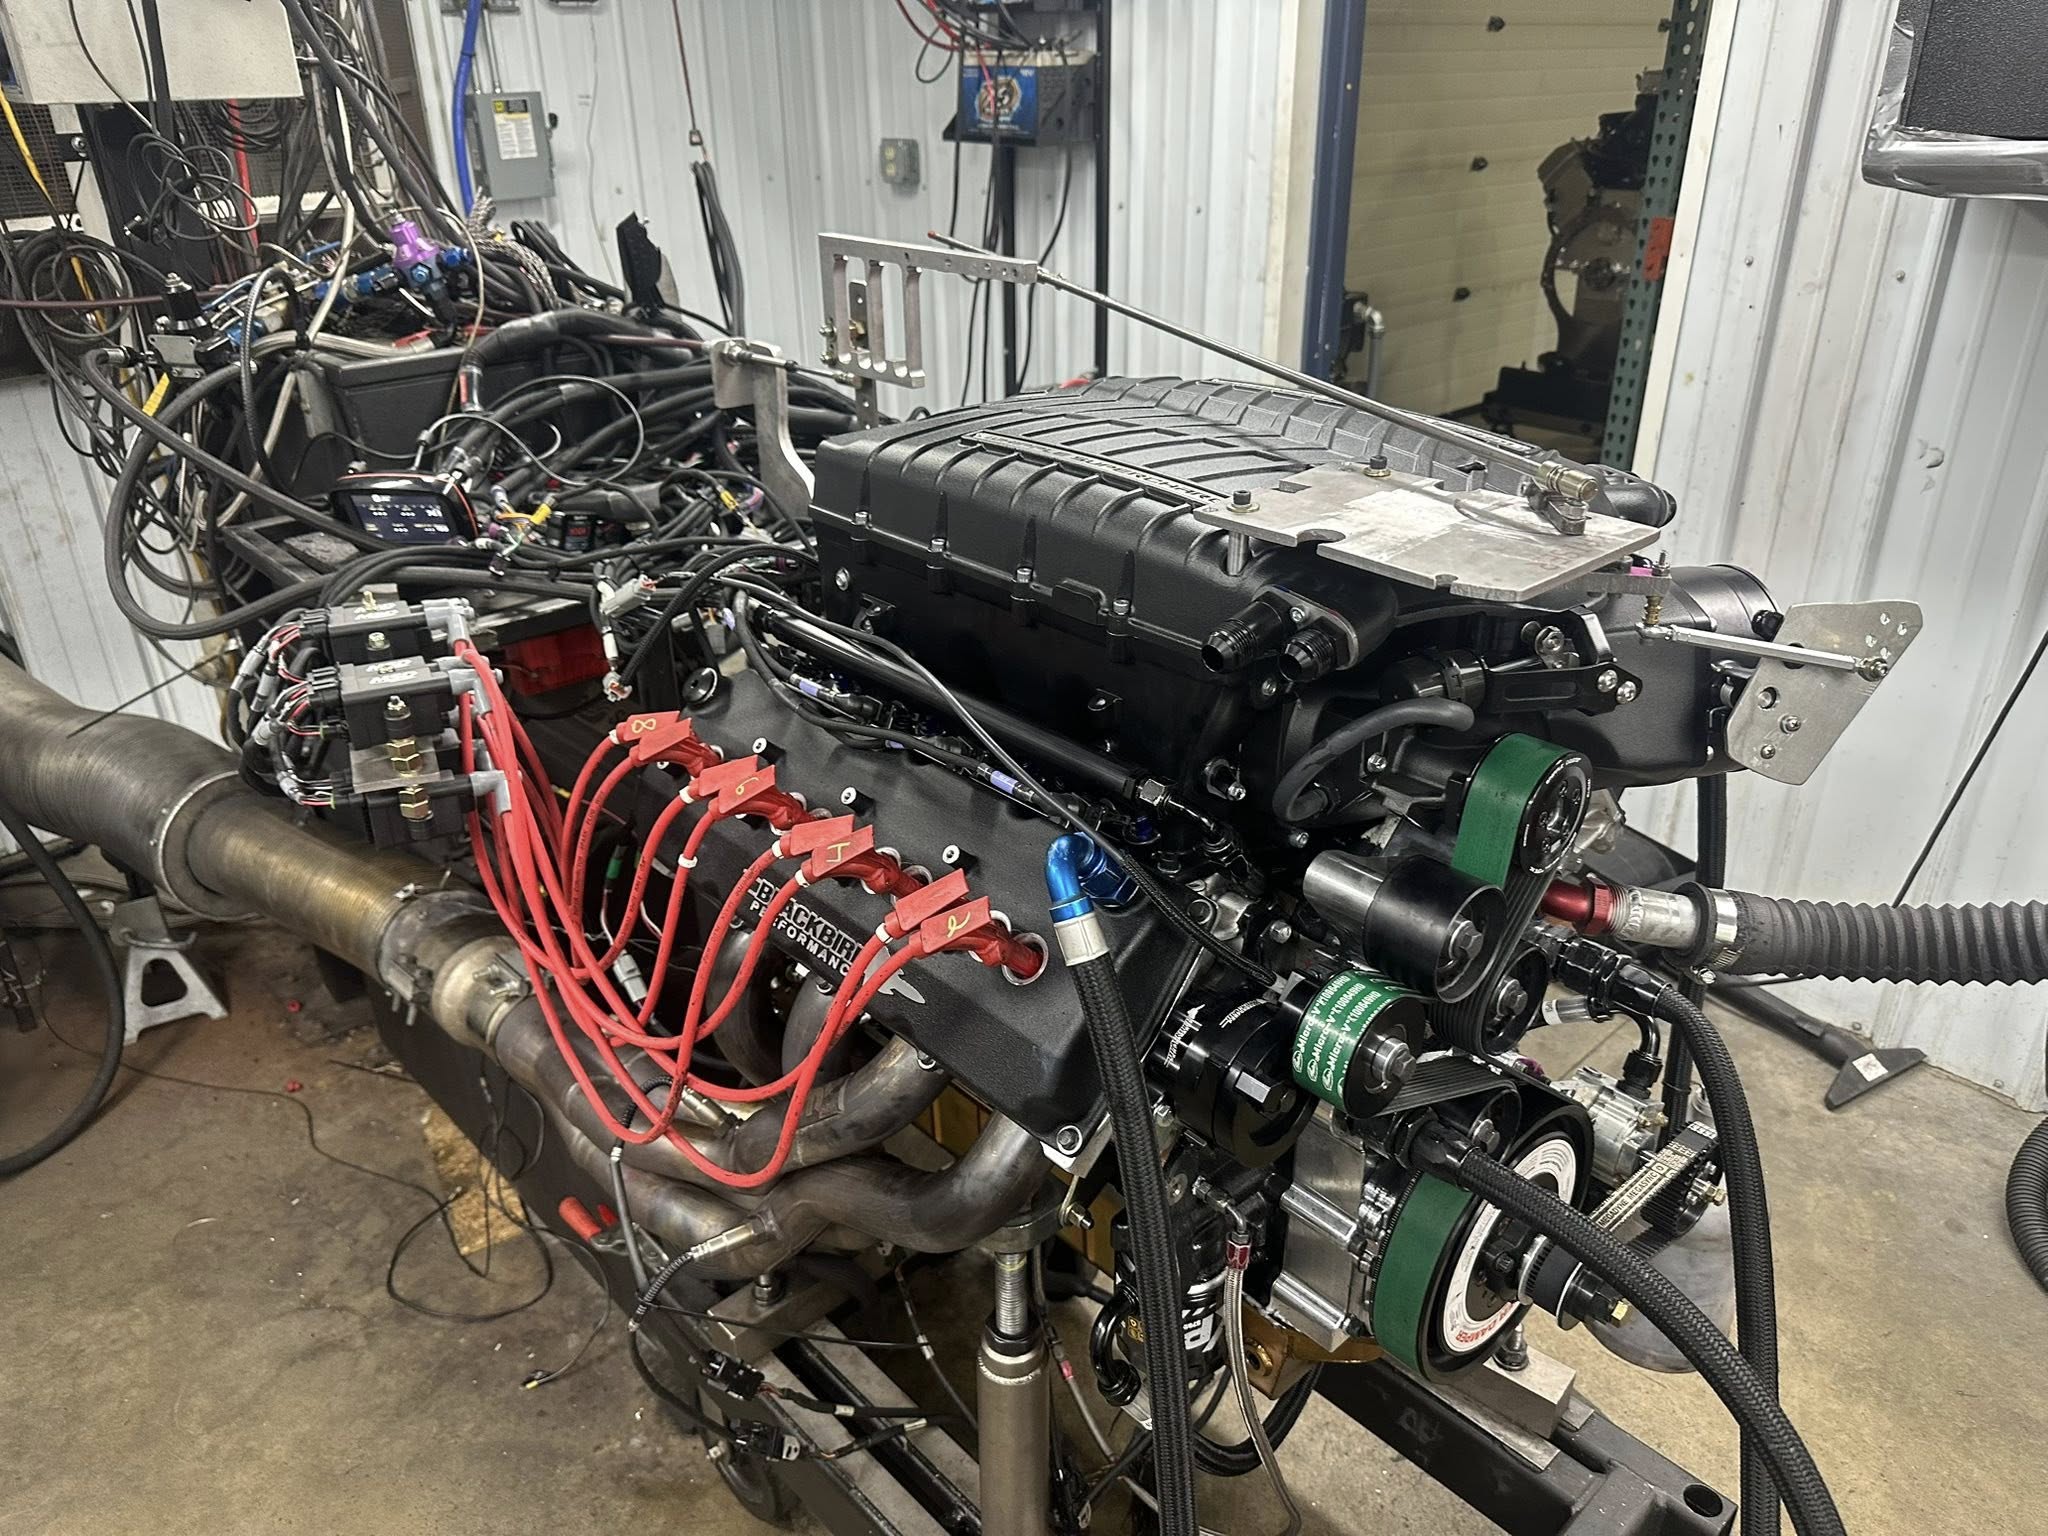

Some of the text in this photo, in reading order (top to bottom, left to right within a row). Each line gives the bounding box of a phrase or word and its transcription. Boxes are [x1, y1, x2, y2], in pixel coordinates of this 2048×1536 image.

[631, 717, 657, 733] 8
[750, 901, 852, 977] PEFORMANC
[753, 878, 865, 965] BACKBIR
